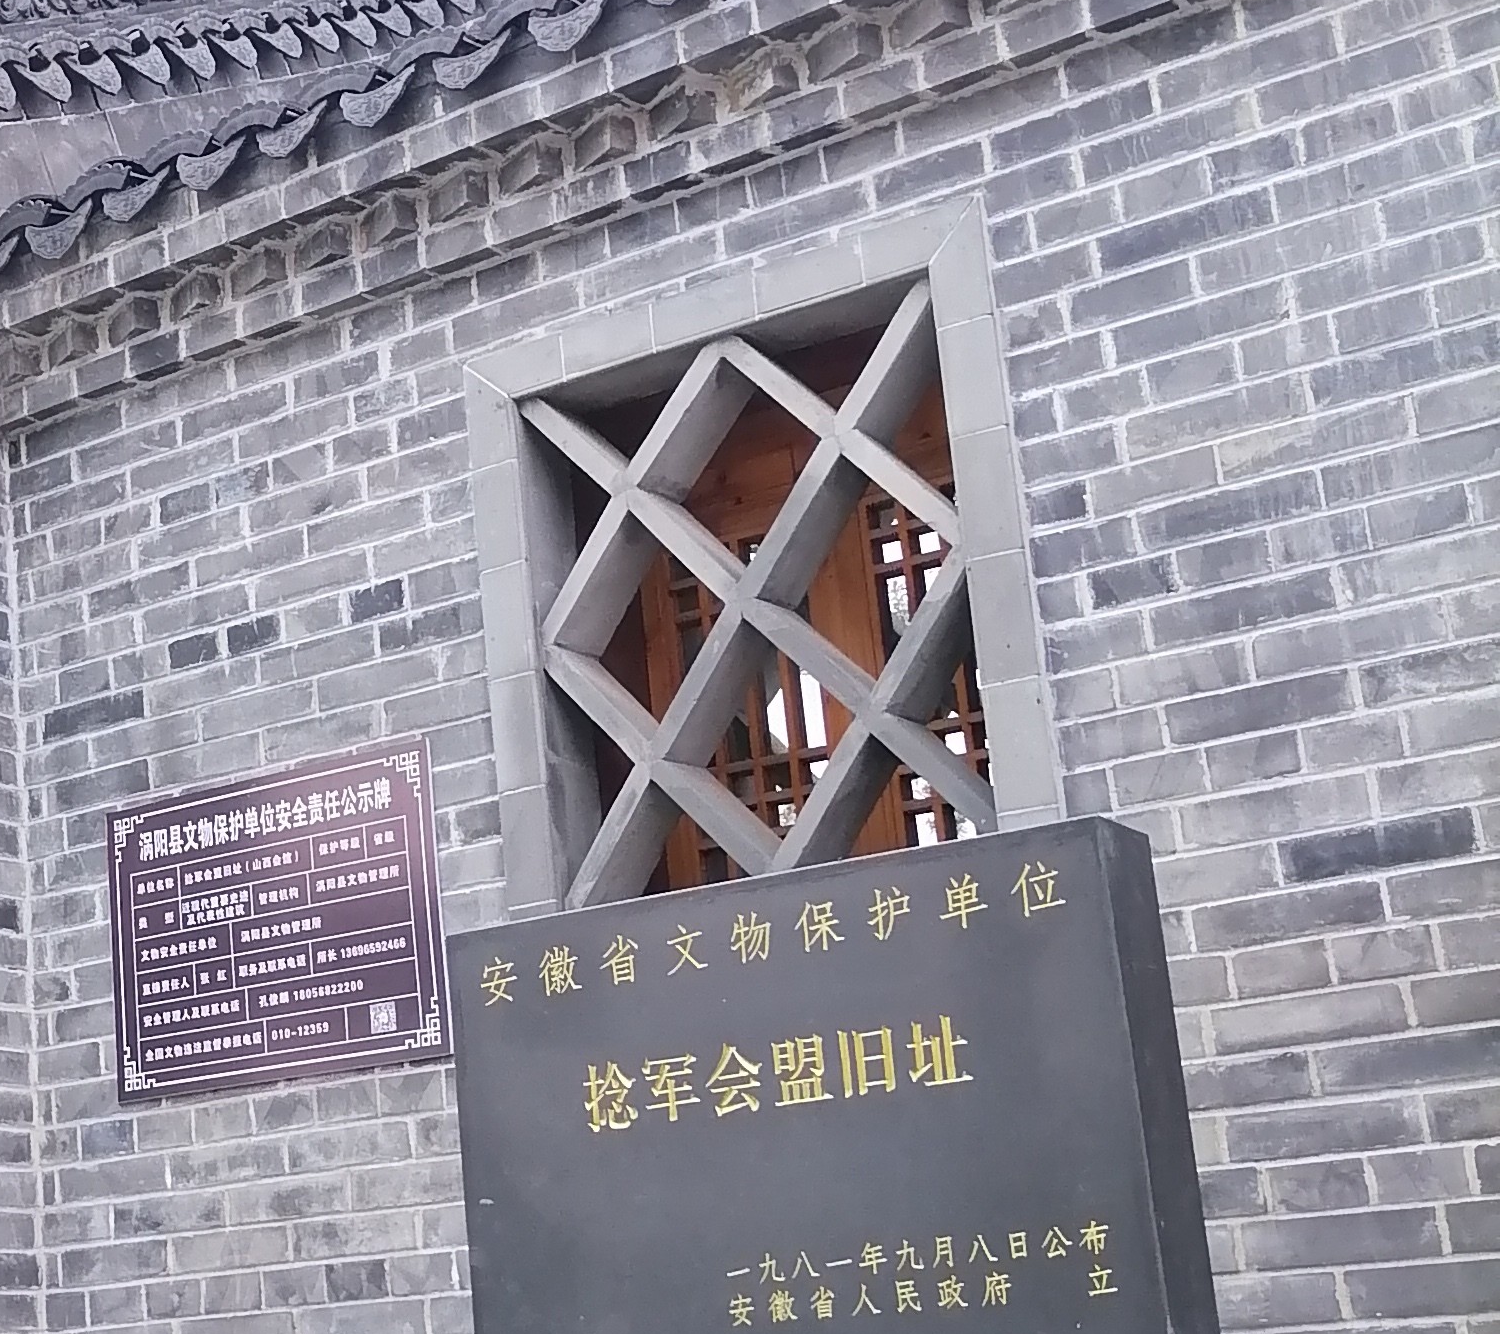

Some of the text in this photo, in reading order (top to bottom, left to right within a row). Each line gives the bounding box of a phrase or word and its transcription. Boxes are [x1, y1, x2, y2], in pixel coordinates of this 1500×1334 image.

[139, 777, 392, 861] 涡阳县文物保护单位安全责任公示牌
[480, 861, 1067, 1007] 安徽省文物保护单位
[583, 1014, 974, 1134] 捻军会盟旧址
[727, 1220, 1110, 1279] 一九八一年九月八日公布
[729, 1264, 1118, 1328] 安徽省人民政府 立
